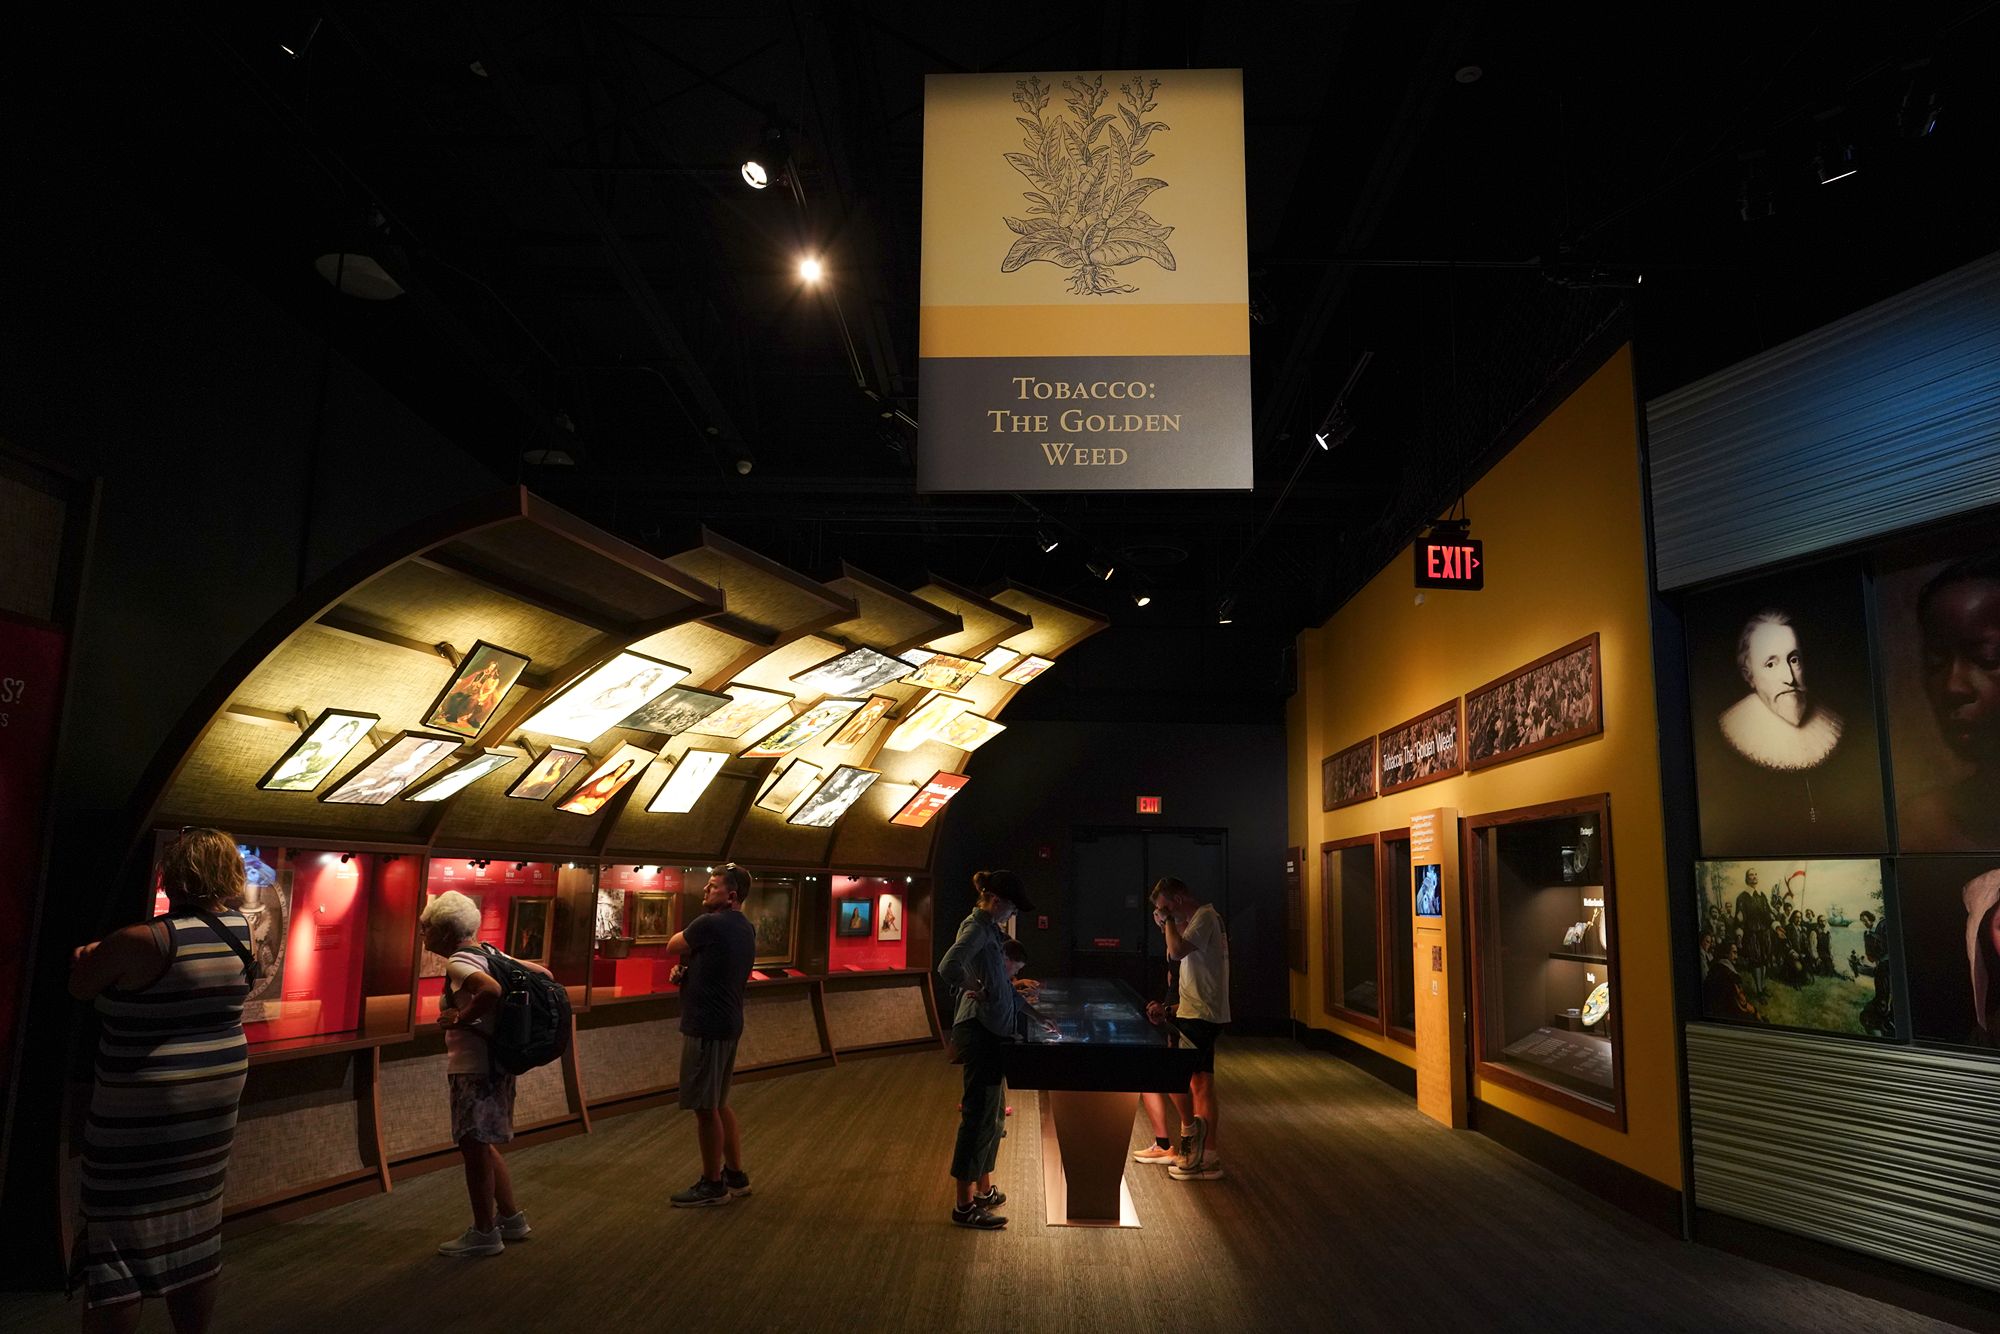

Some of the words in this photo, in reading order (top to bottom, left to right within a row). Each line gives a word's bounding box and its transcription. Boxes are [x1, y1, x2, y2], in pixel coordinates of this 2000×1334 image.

[1012, 377, 1155, 400] TOBACCO:
[987, 410, 1049, 433] THE
[1060, 409, 1182, 433] GOLDEN
[1041, 443, 1128, 466] WEED
[1427, 545, 1475, 580] EXIT
